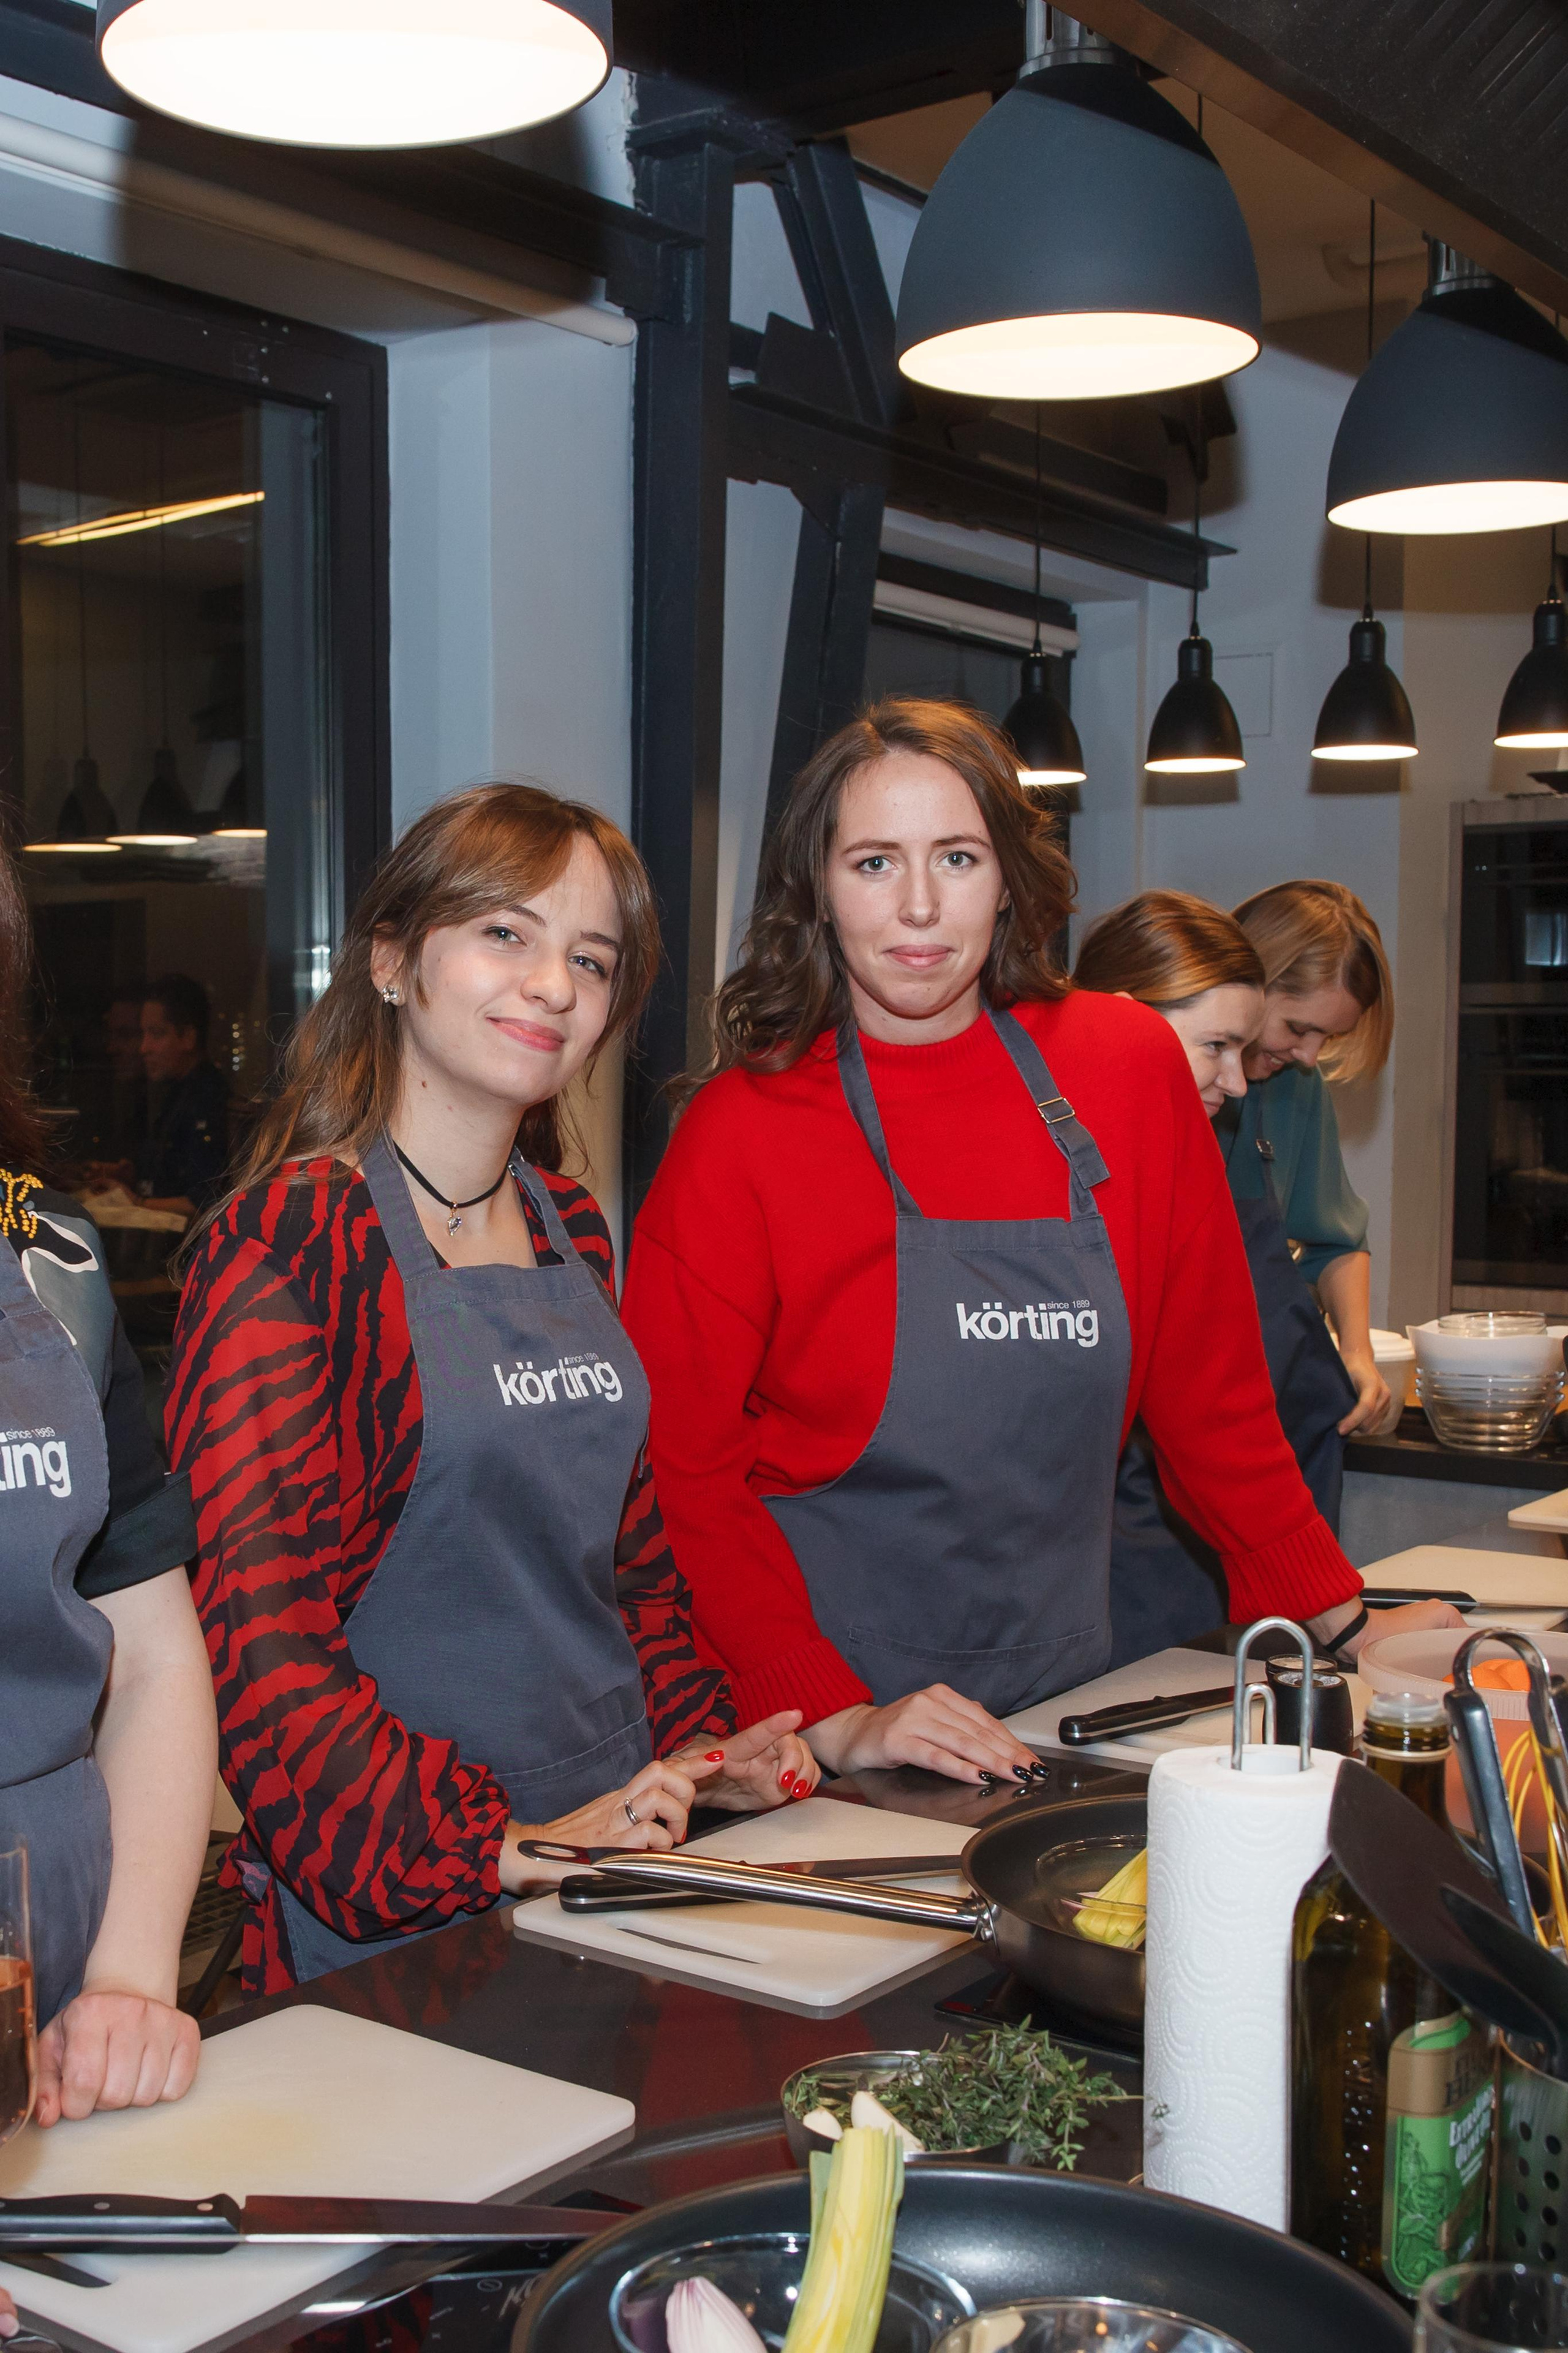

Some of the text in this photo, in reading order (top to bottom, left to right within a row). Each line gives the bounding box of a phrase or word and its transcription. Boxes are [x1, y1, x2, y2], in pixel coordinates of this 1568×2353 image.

[956, 1302, 1099, 1348] körting
[1072, 1299, 1090, 1309] 1889
[493, 1357, 623, 1406] körting
[6, 1427, 56, 1440] since 1889
[0, 1432, 72, 1498] ing
